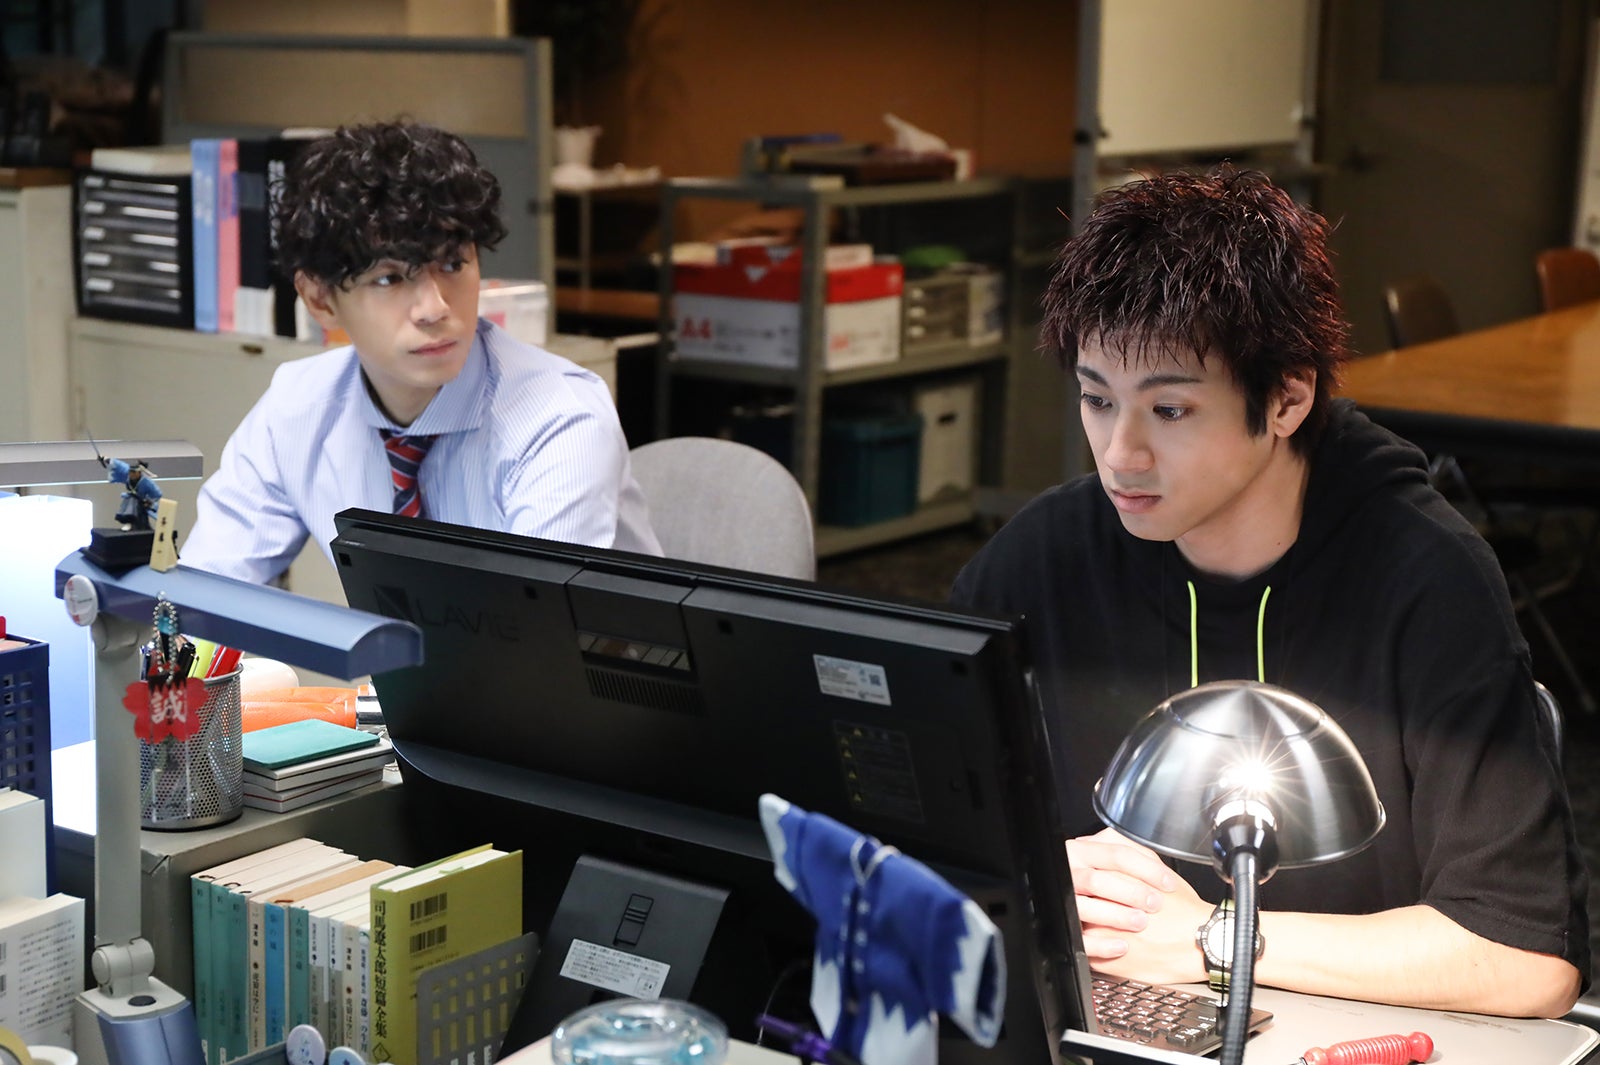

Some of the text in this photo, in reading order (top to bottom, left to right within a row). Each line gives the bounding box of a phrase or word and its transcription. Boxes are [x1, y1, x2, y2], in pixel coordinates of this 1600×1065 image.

[415, 597, 521, 642] LAVIE
[151, 688, 187, 725] 誠
[374, 899, 388, 1039] 司馬遼太郎短篇全集
